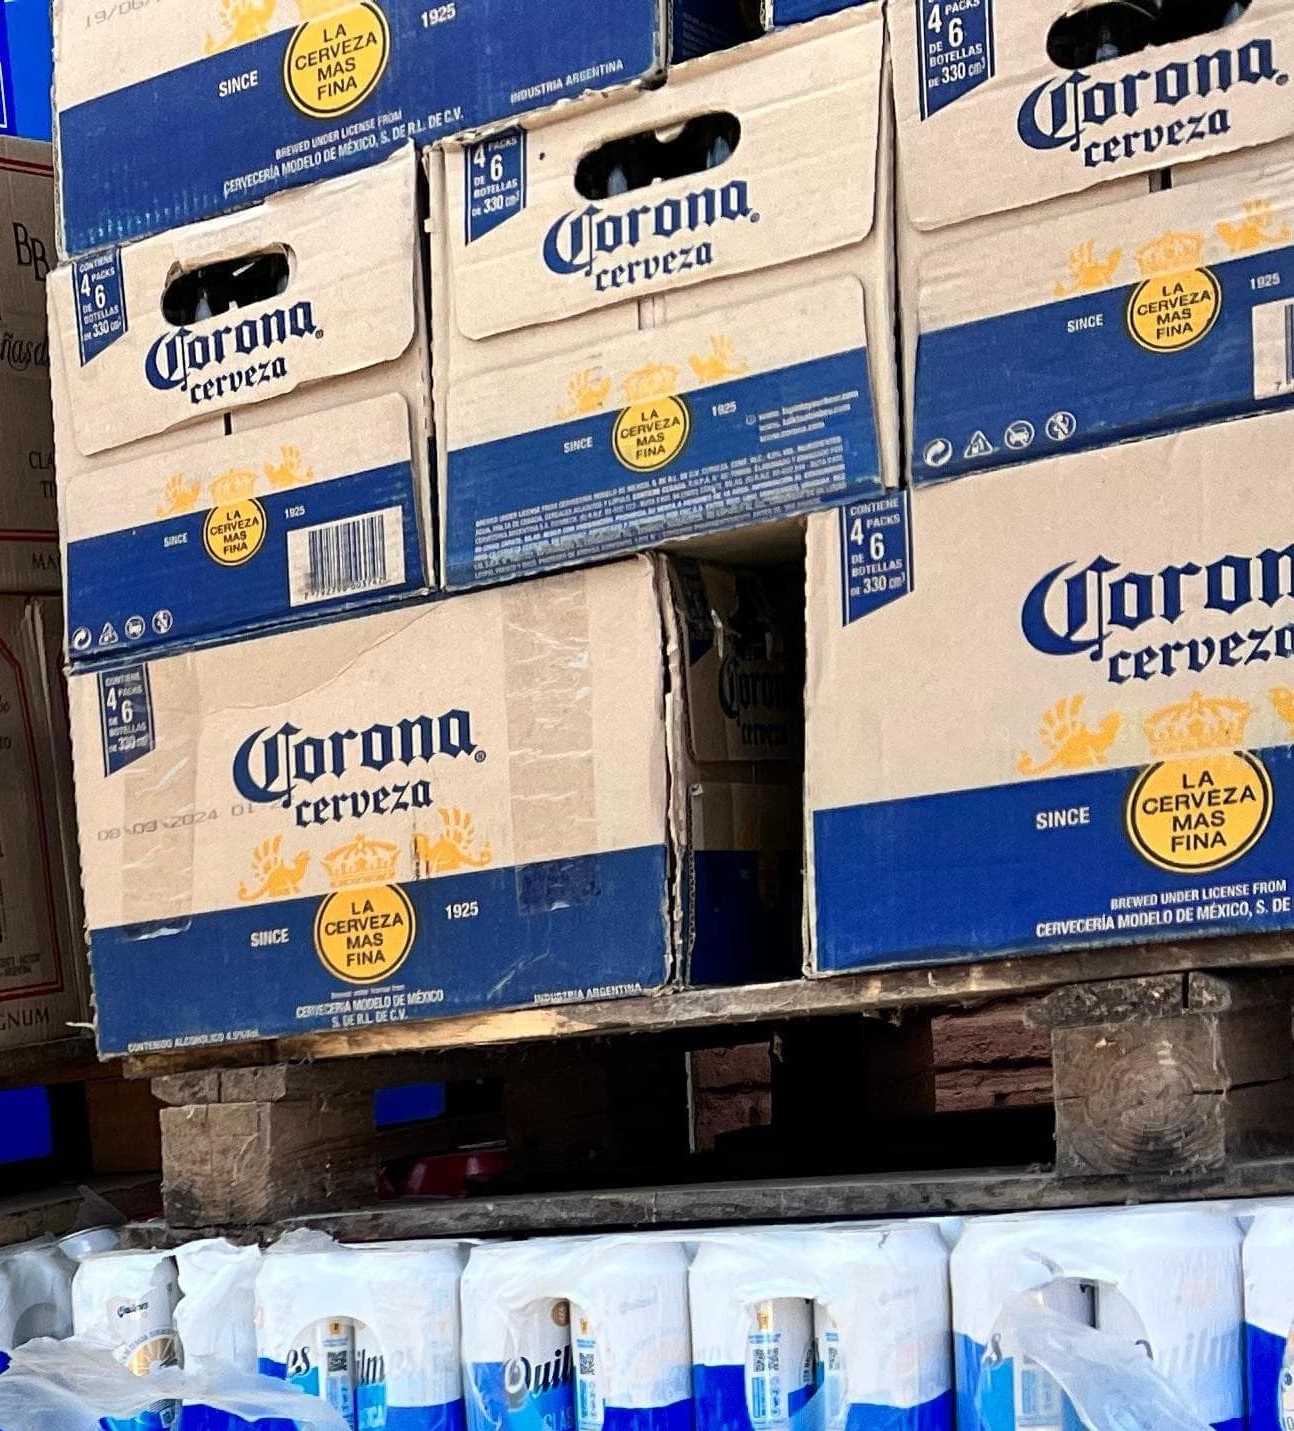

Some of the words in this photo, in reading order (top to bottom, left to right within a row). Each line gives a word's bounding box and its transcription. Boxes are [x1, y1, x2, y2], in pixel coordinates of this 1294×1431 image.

[323, 24, 347, 44] LA
[219, 70, 259, 97] SINCE
[420, 4, 457, 28] 1925
[294, 33, 378, 71] CERVEZA
[929, 42, 982, 67] BOTELLAS
[316, 57, 357, 83] MAS
[941, 63, 965, 83] 330
[316, 78, 359, 100] FINA
[510, 79, 564, 105] INDUSTRIA
[565, 59, 624, 90] ARGENTINA
[1018, 38, 1278, 151] Corona
[1083, 107, 1230, 168] cerveza
[223, 163, 280, 197] CERVECERÍA
[281, 152, 322, 182] MODELO
[323, 149, 338, 168] DE
[338, 133, 379, 164] MÉXICO,
[380, 134, 391, 152] S.
[392, 125, 407, 144] DE
[428, 116, 442, 134] DE
[443, 107, 464, 128] C.V.
[543, 179, 752, 277] Corona
[595, 242, 712, 291] cerveza
[1137, 288, 1211, 318] CERVEZA
[1067, 314, 1104, 333] SINCE
[1155, 306, 1193, 325] MAS
[1155, 321, 1193, 339] FINA
[145, 301, 316, 391] Corona
[190, 356, 288, 404] cerveza
[620, 416, 681, 440] CERVEZA
[636, 432, 665, 447] MAS
[636, 444, 666, 460] FINA
[226, 510, 241, 521] LA
[850, 500, 898, 517] CONTIENE
[210, 517, 259, 536] CERVEZA
[223, 531, 247, 544] MAS
[850, 518, 863, 546] 4
[866, 513, 901, 529] PACKS
[223, 542, 248, 555] FINA
[870, 532, 885, 561] 6
[852, 557, 903, 578] BOTELLAS
[1021, 543, 1294, 662] Coron
[232, 708, 478, 809] Corona
[1182, 770, 1214, 790] LA
[294, 776, 433, 828] cerveza
[1142, 784, 1255, 815] CERVEZA
[1036, 808, 1090, 831] SINCE
[1172, 810, 1225, 831] MAS
[1171, 832, 1226, 854] FINA
[1111, 893, 1158, 911] BREWED
[1161, 889, 1198, 906] UNDER
[1202, 884, 1249, 902] LICENSE
[1253, 880, 1286, 897] FROM
[351, 900, 374, 917] LA
[250, 928, 290, 948] SINCE
[444, 901, 479, 920] 1925
[324, 913, 404, 936] CERVEZA
[346, 933, 384, 950] MAS
[346, 950, 386, 968] FINA
